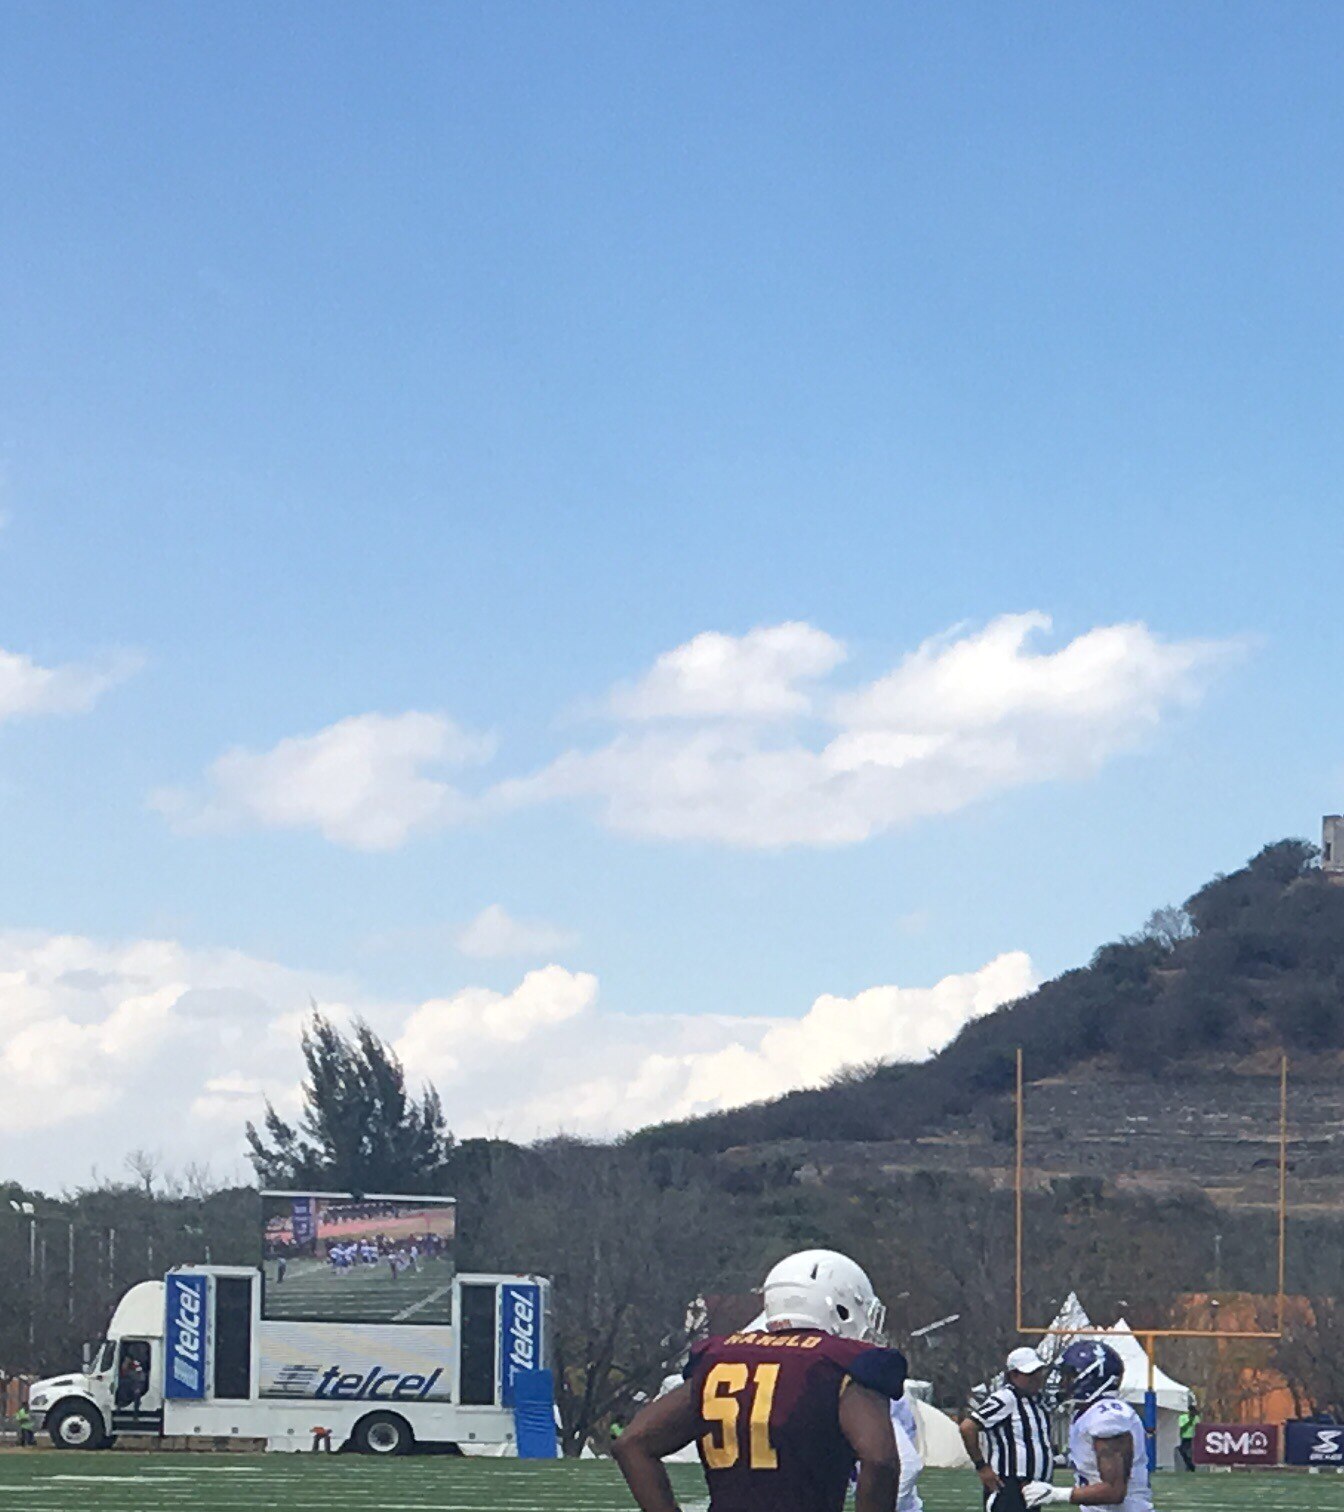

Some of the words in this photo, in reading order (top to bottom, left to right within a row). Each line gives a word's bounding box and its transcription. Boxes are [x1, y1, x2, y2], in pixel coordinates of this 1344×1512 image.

[174, 1280, 200, 1361] telcel
[509, 1290, 534, 1370] telcel
[315, 1365, 444, 1399] telcel
[702, 1363, 781, 1469] 51
